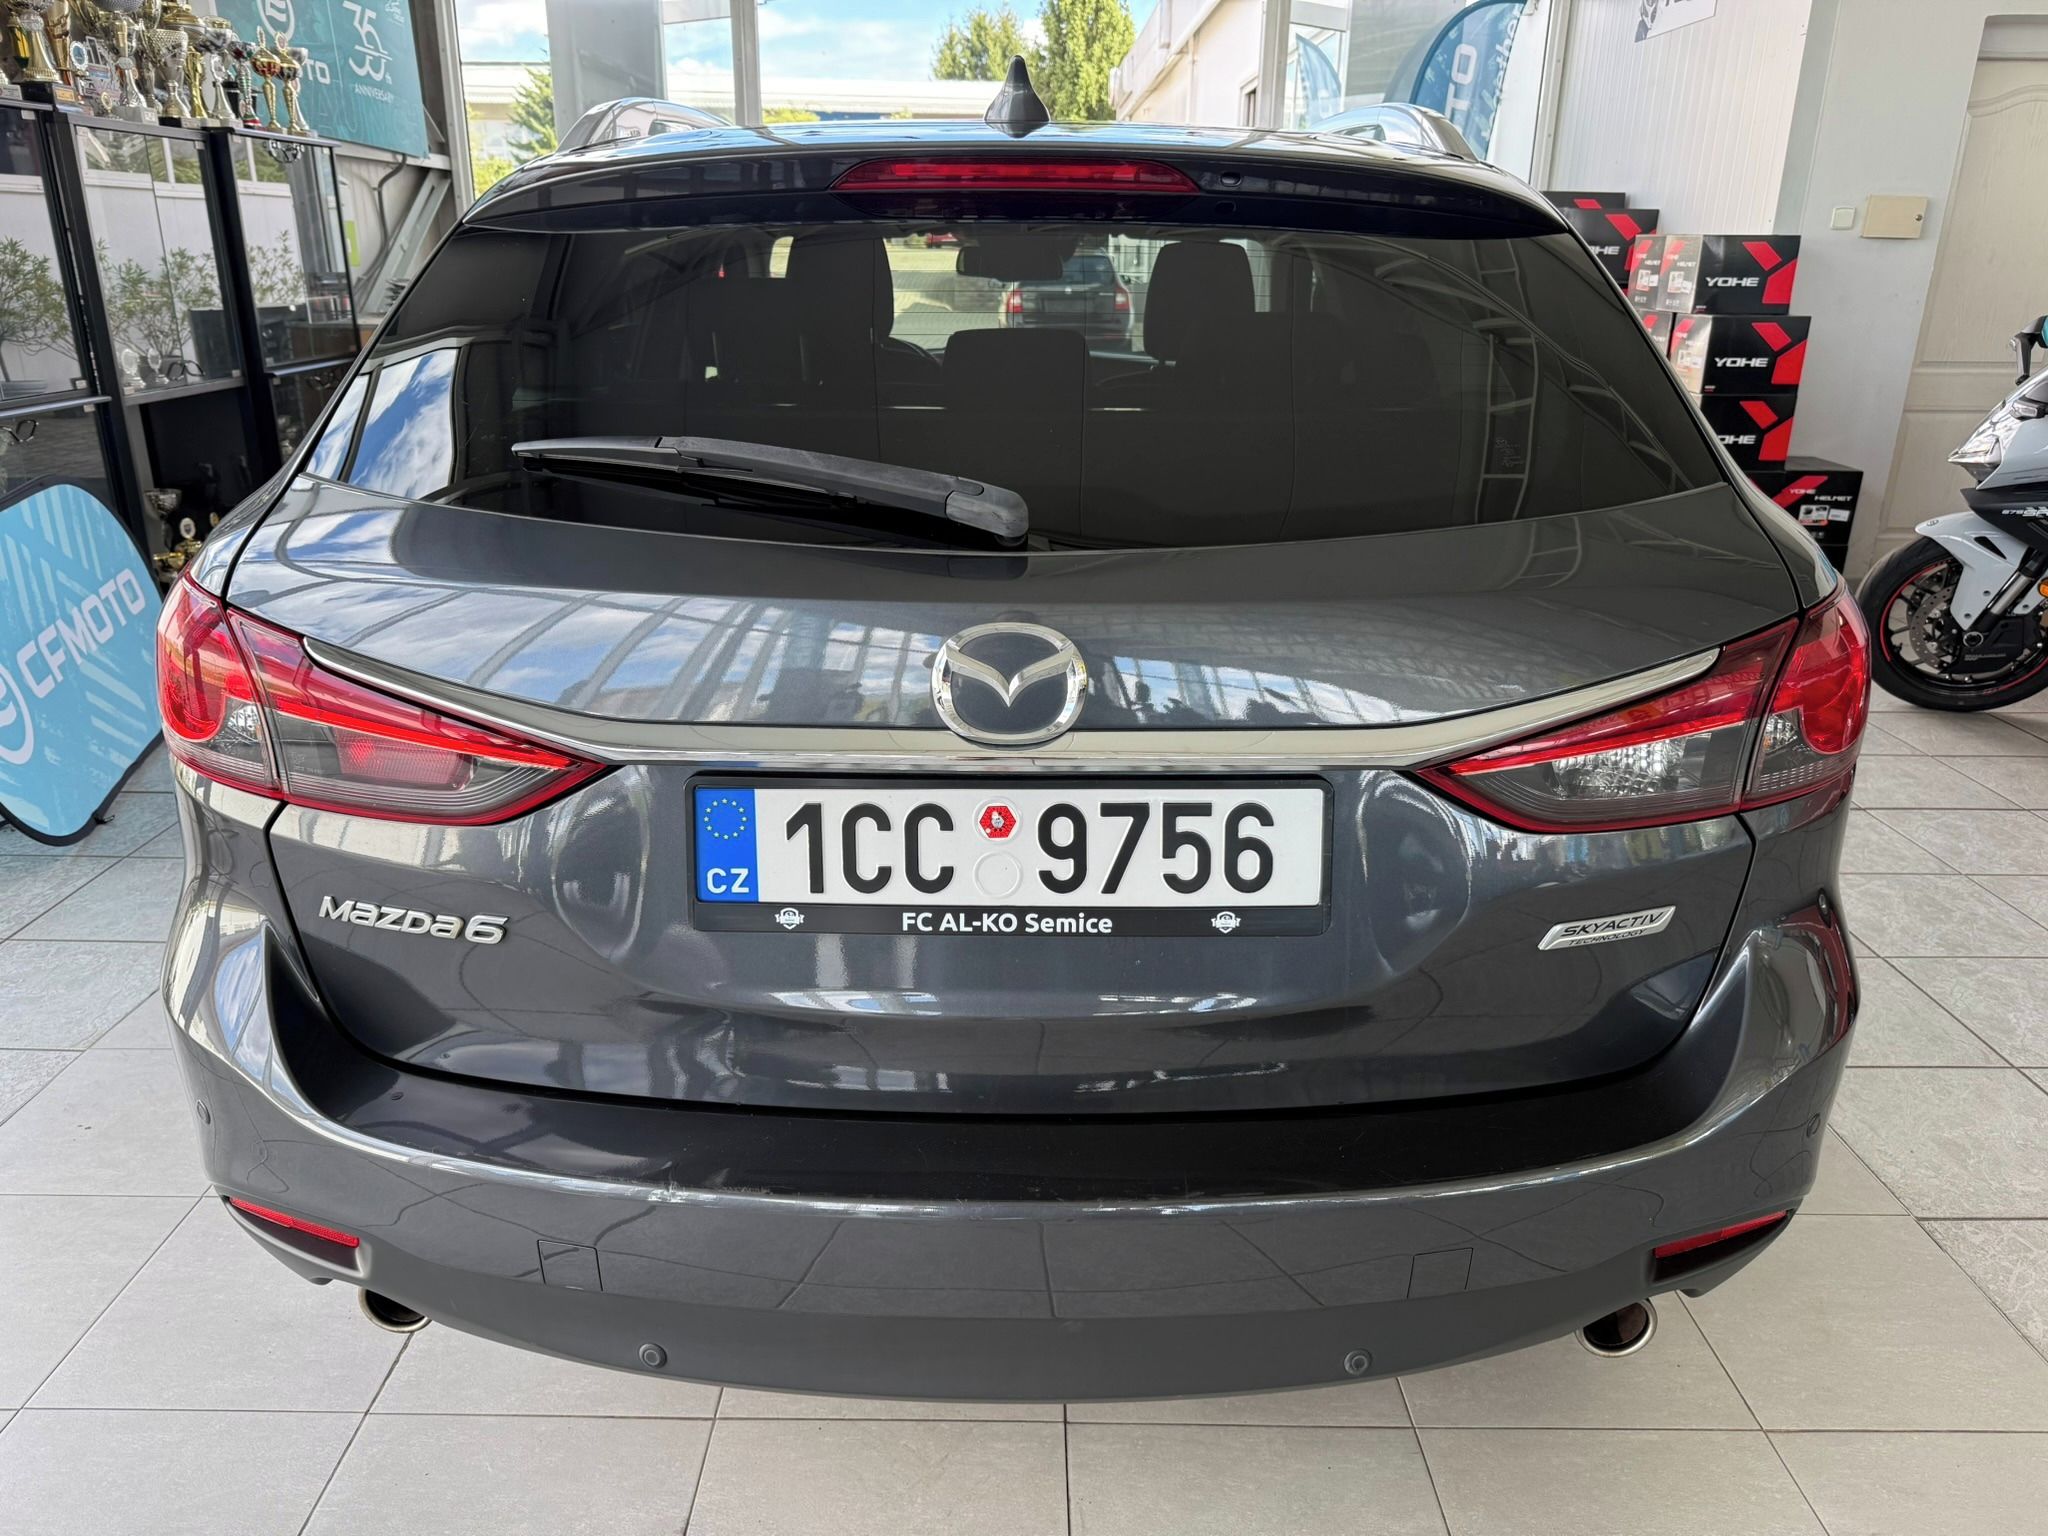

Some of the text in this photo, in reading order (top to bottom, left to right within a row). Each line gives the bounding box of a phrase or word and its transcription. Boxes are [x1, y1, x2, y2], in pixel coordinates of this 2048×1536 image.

[1705, 277, 1760, 287] YOHE
[1714, 357, 1769, 368] YOHE
[1717, 435, 1756, 444] OHE
[16, 569, 147, 699] CFMOTO
[786, 803, 1275, 894] 1CC 9756
[706, 868, 749, 894] CZ
[902, 912, 1113, 934] FC AL-KO Semice
[1561, 911, 1664, 938] SKYACTIV
[1569, 929, 1648, 946] TECHNOLOGY
